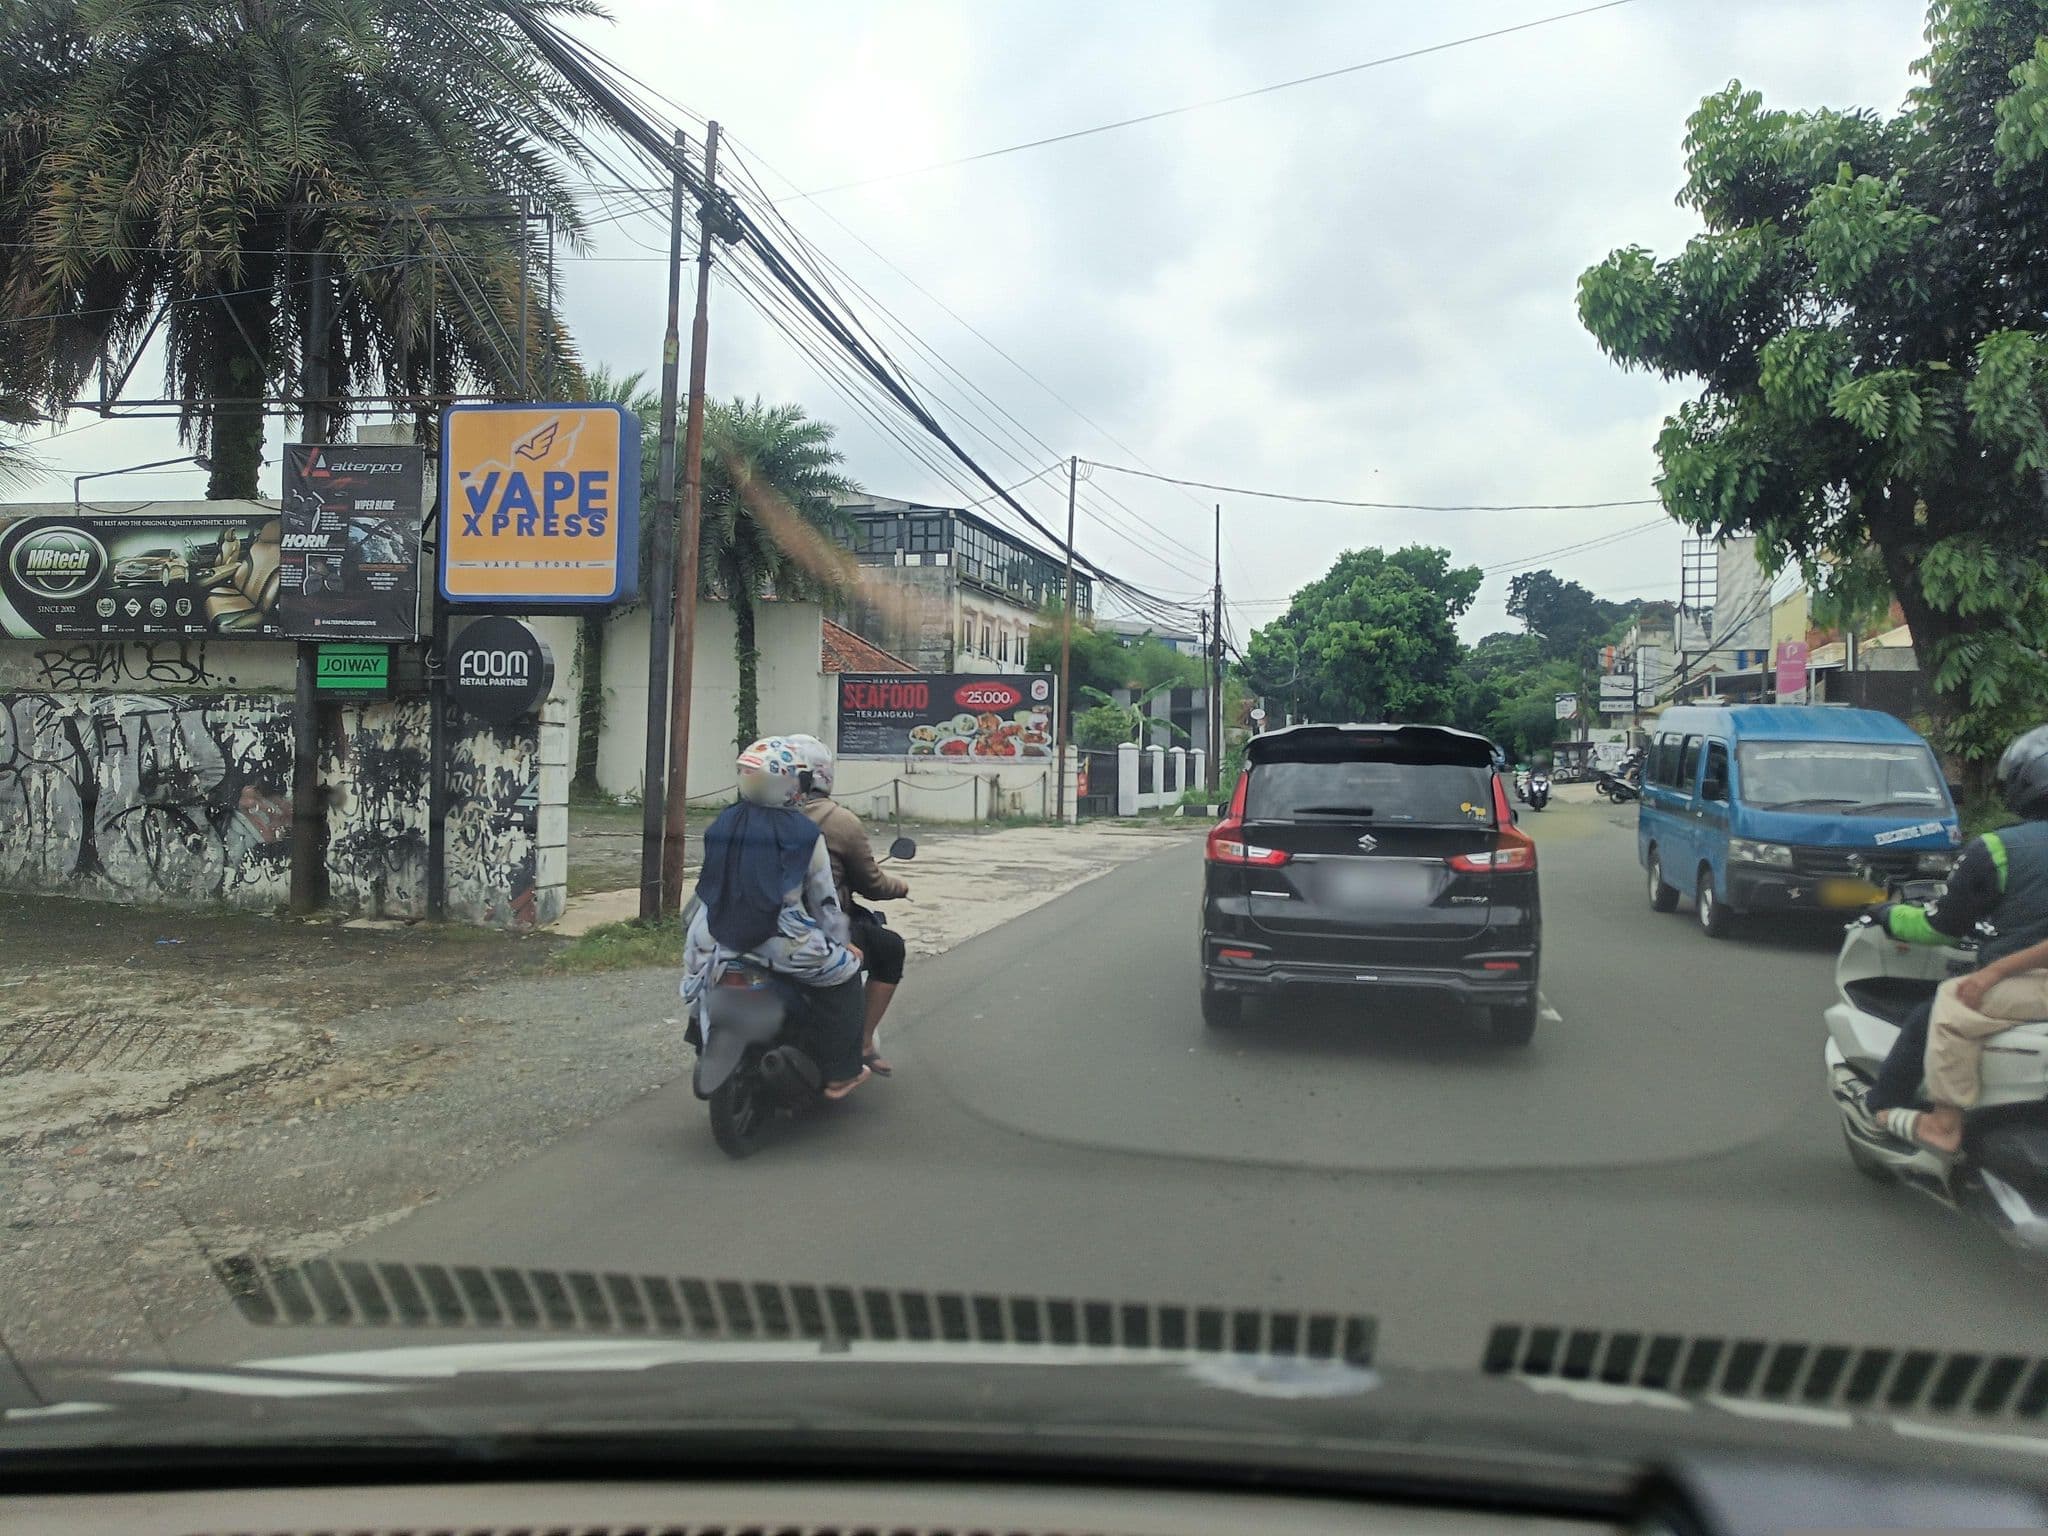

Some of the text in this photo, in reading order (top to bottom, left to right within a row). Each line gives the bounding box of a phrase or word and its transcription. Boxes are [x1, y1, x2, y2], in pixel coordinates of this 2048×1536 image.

[331, 461, 403, 474] alterpro
[458, 470, 609, 518] VAPE
[461, 513, 607, 538] XPRESS
[280, 534, 330, 548] HORN
[27, 549, 90, 569] MBtech
[534, 560, 581, 568] STORE
[37, 605, 76, 613] SINCE 2002
[323, 658, 381, 672] JOIWAY
[460, 650, 529, 677] FOOM
[460, 677, 528, 686] RETAIL PARTNER
[843, 683, 929, 710] SEAFOOD
[855, 709, 914, 719] TERJANGKAU
